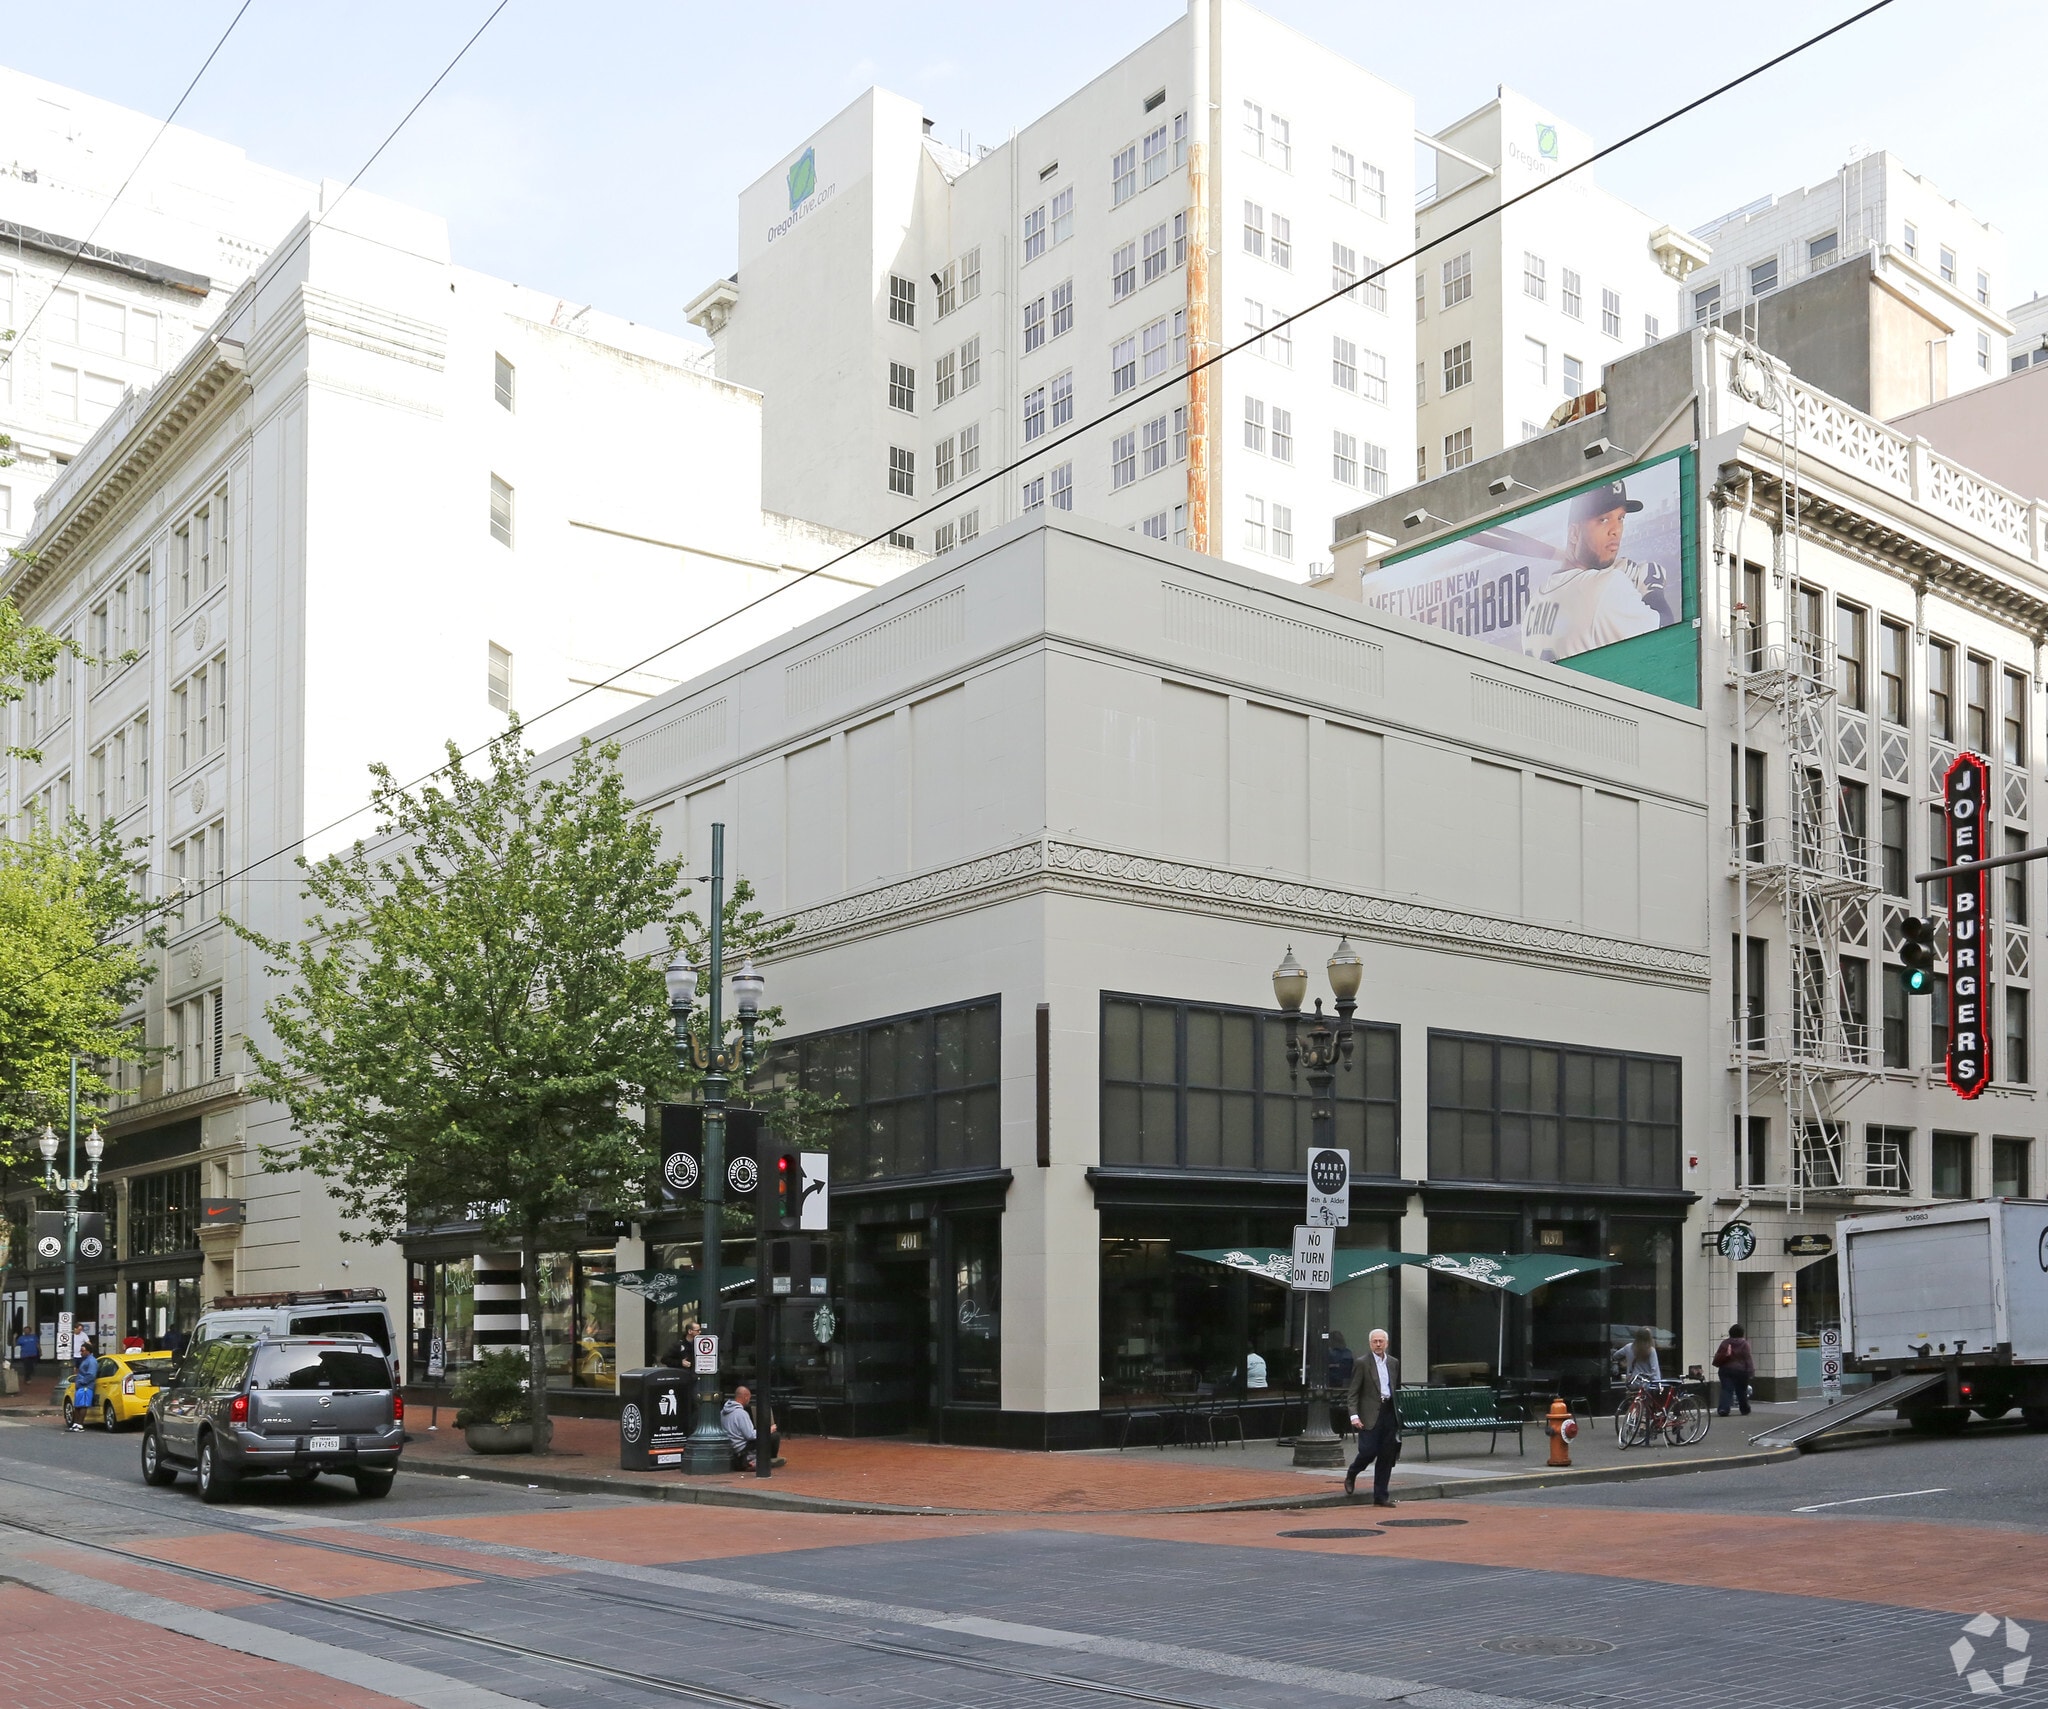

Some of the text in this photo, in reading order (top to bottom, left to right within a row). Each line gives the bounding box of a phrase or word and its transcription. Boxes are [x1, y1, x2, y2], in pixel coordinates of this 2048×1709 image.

[767, 183, 836, 243] OregonLive.com
[1406, 579, 1443, 615] YOUR
[1447, 570, 1480, 598] NEW
[1526, 601, 1560, 637] CANO
[1955, 892, 1976, 1079] BURGERS
[1314, 1162, 1344, 1171] SMART
[1317, 1172, 1341, 1180] PARK
[1904, 1213, 1929, 1222] 104983
[900, 1234, 917, 1249] 401
[1308, 1234, 1321, 1247] NO
[1300, 1252, 1325, 1264] TURN
[1294, 1269, 1330, 1283] ON RED
[720, 1279, 756, 1292] ARBUCKS
